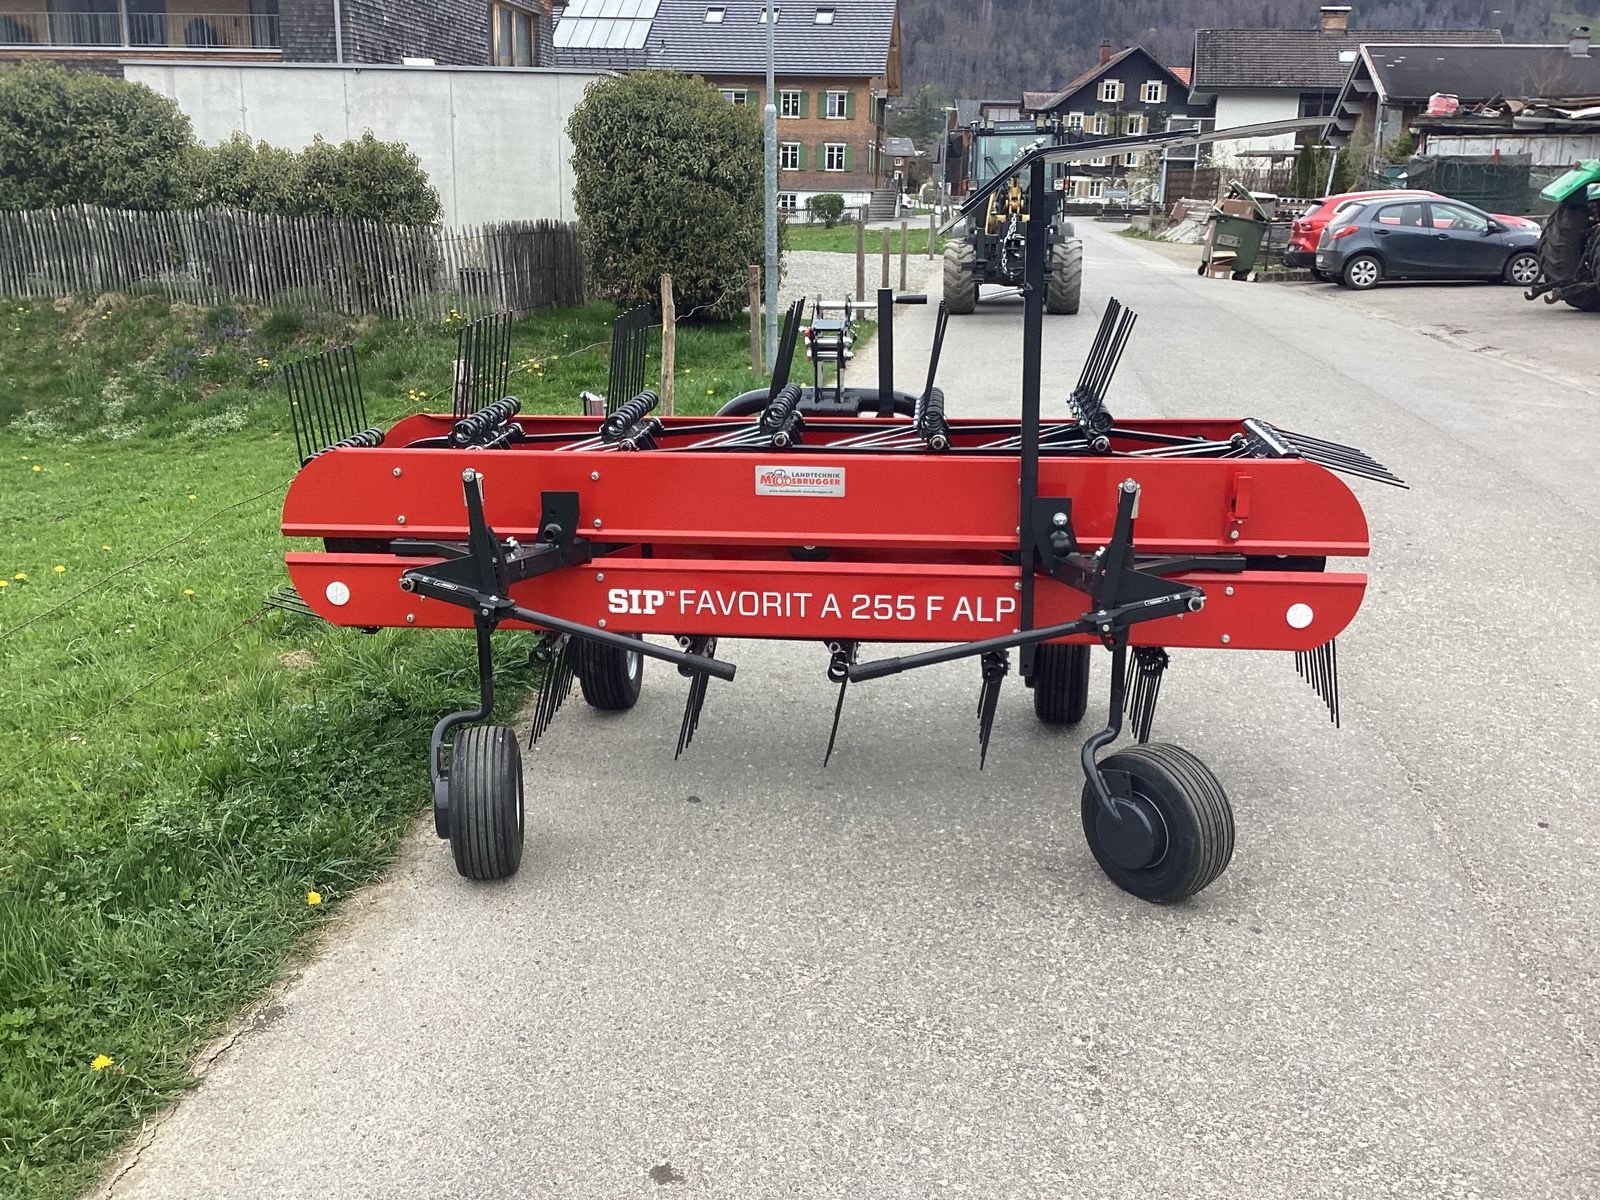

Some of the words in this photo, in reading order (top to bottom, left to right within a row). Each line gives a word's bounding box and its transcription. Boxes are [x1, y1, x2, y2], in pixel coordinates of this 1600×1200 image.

[679, 589, 812, 618] FAVORIT
[820, 593, 842, 619] A
[851, 594, 916, 621] 255
[926, 595, 945, 621] F
[952, 596, 1016, 622] ALP
